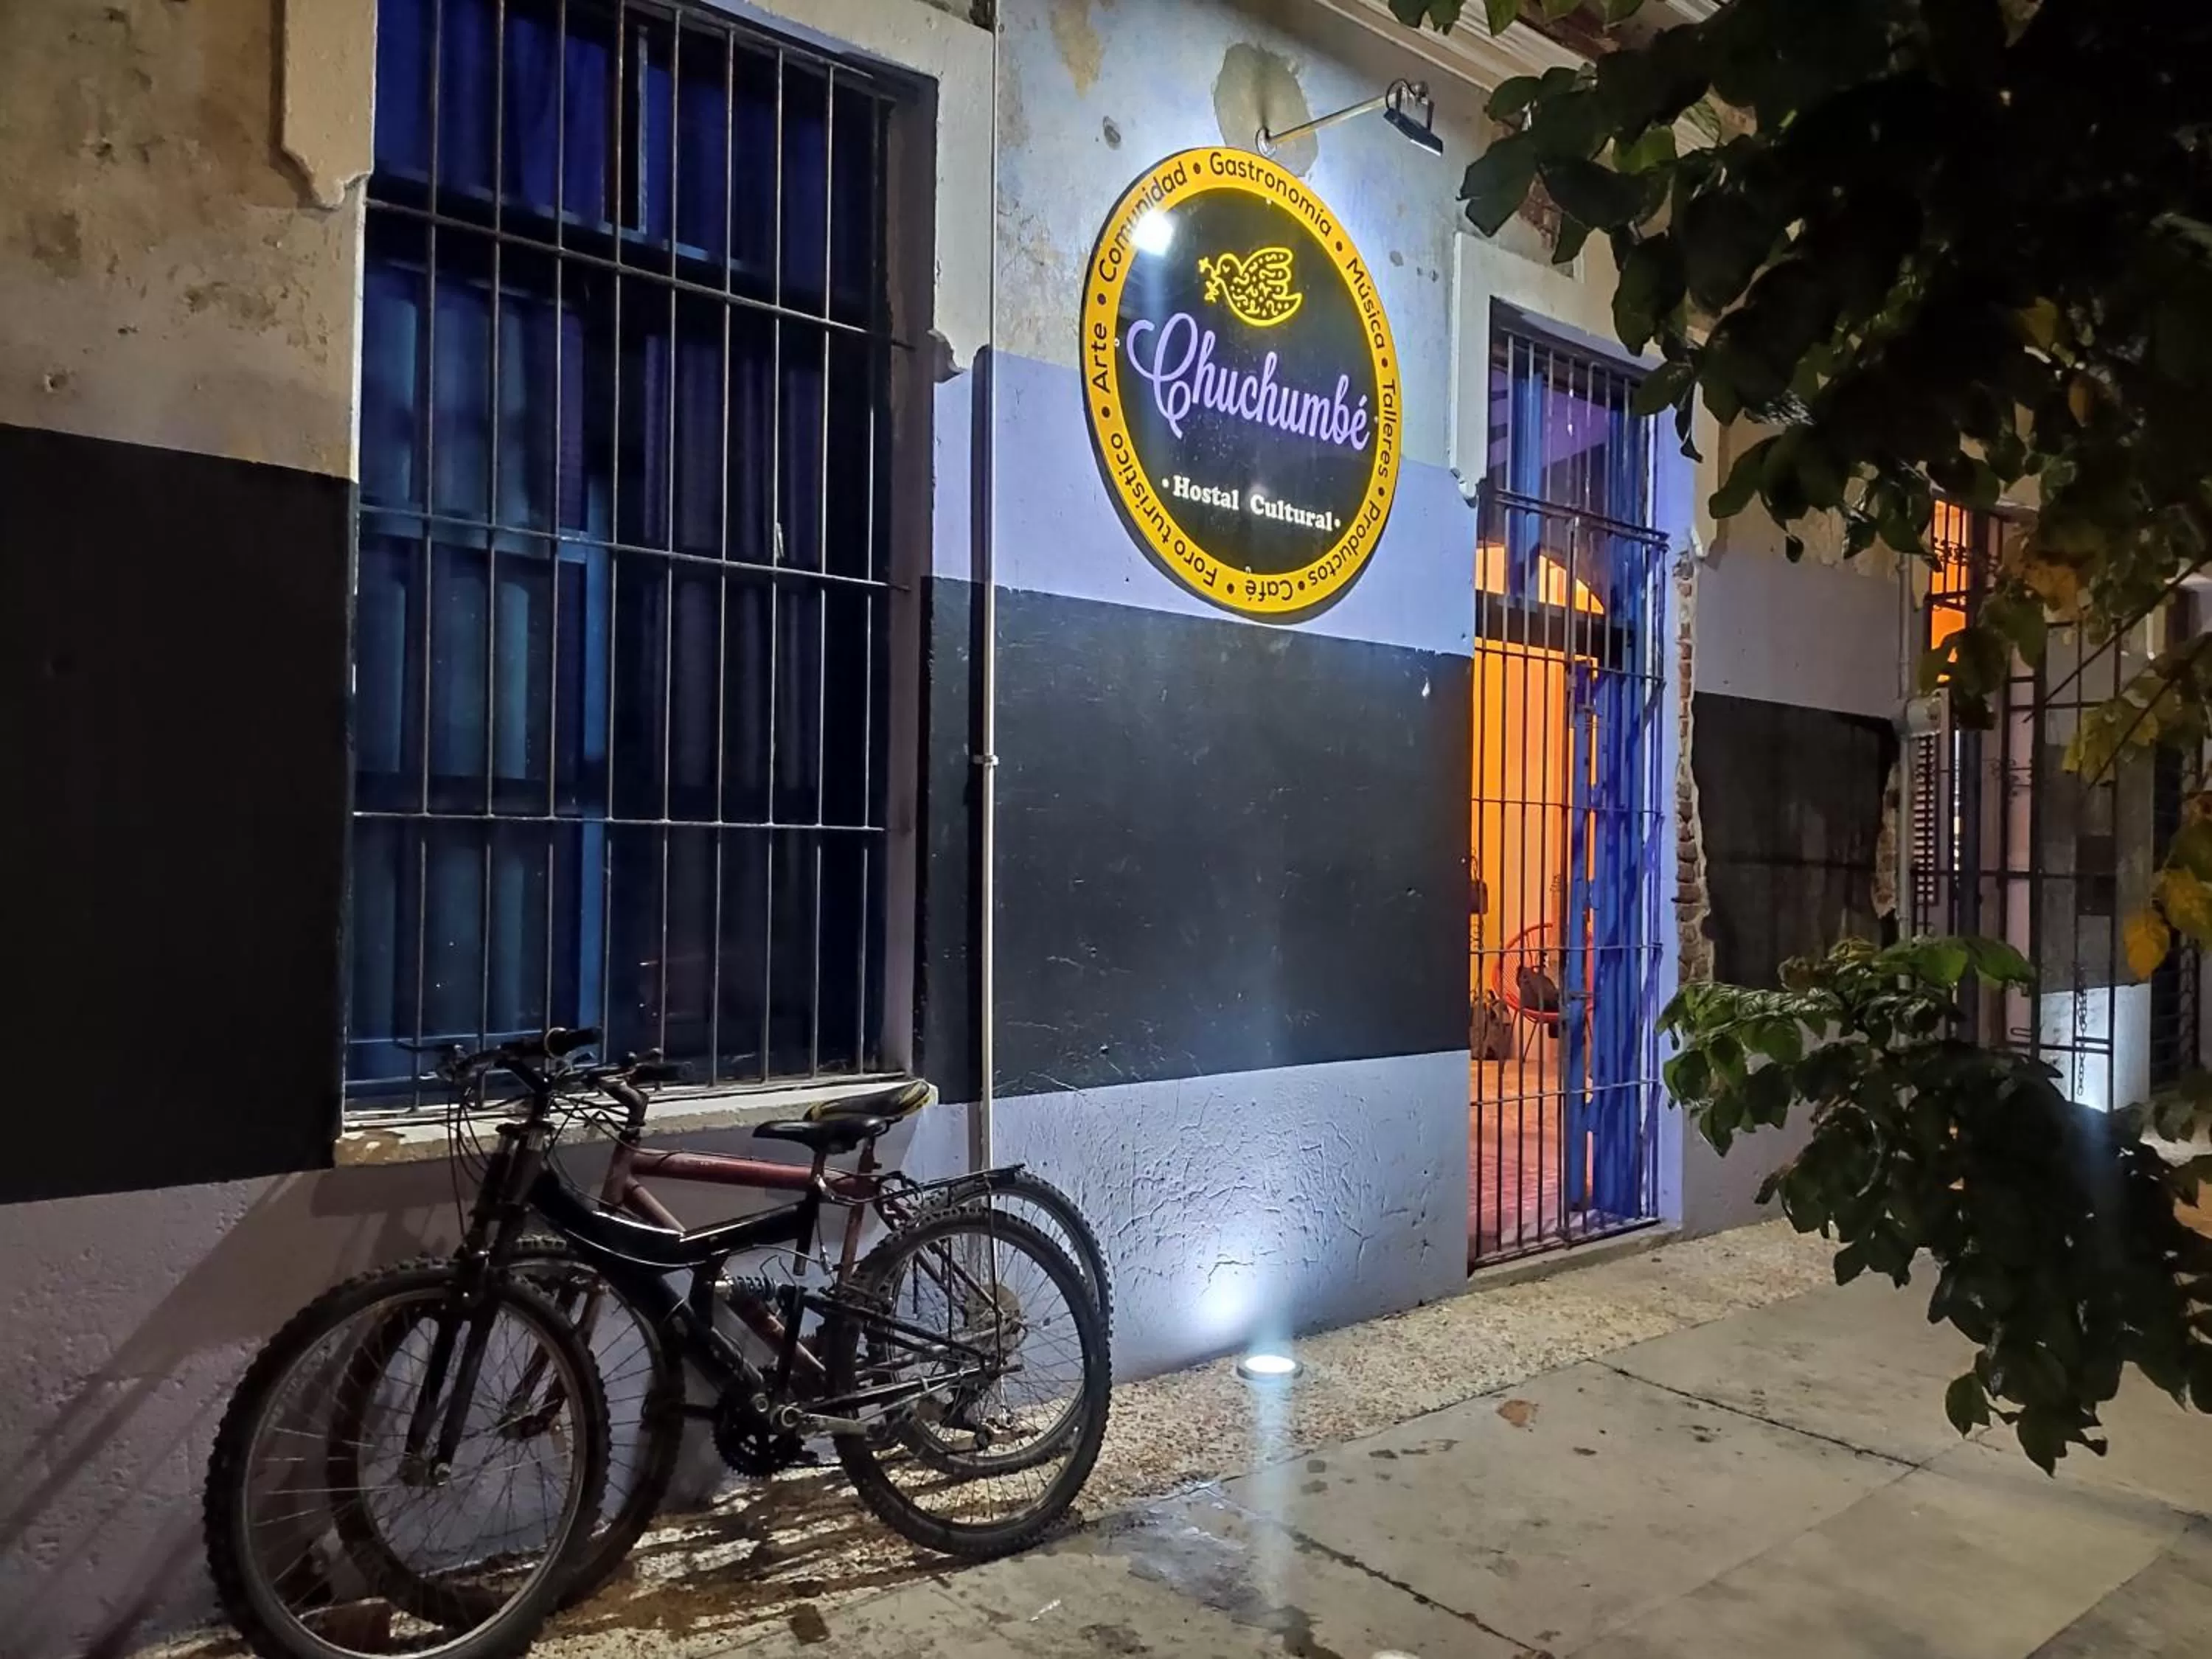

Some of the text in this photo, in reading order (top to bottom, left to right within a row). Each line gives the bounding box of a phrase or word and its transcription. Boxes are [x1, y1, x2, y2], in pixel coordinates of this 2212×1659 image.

[1346, 257, 1387, 349] Música
[1091, 321, 1110, 394] Arte
[1126, 312, 1371, 451] Chuchumbé
[1378, 378, 1398, 478] Talleres
[1110, 432, 1219, 588] Foro turístico
[1172, 475, 1333, 532] Hostal Cultural
[1307, 499, 1381, 587] Productos
[1245, 579, 1294, 602] Café
